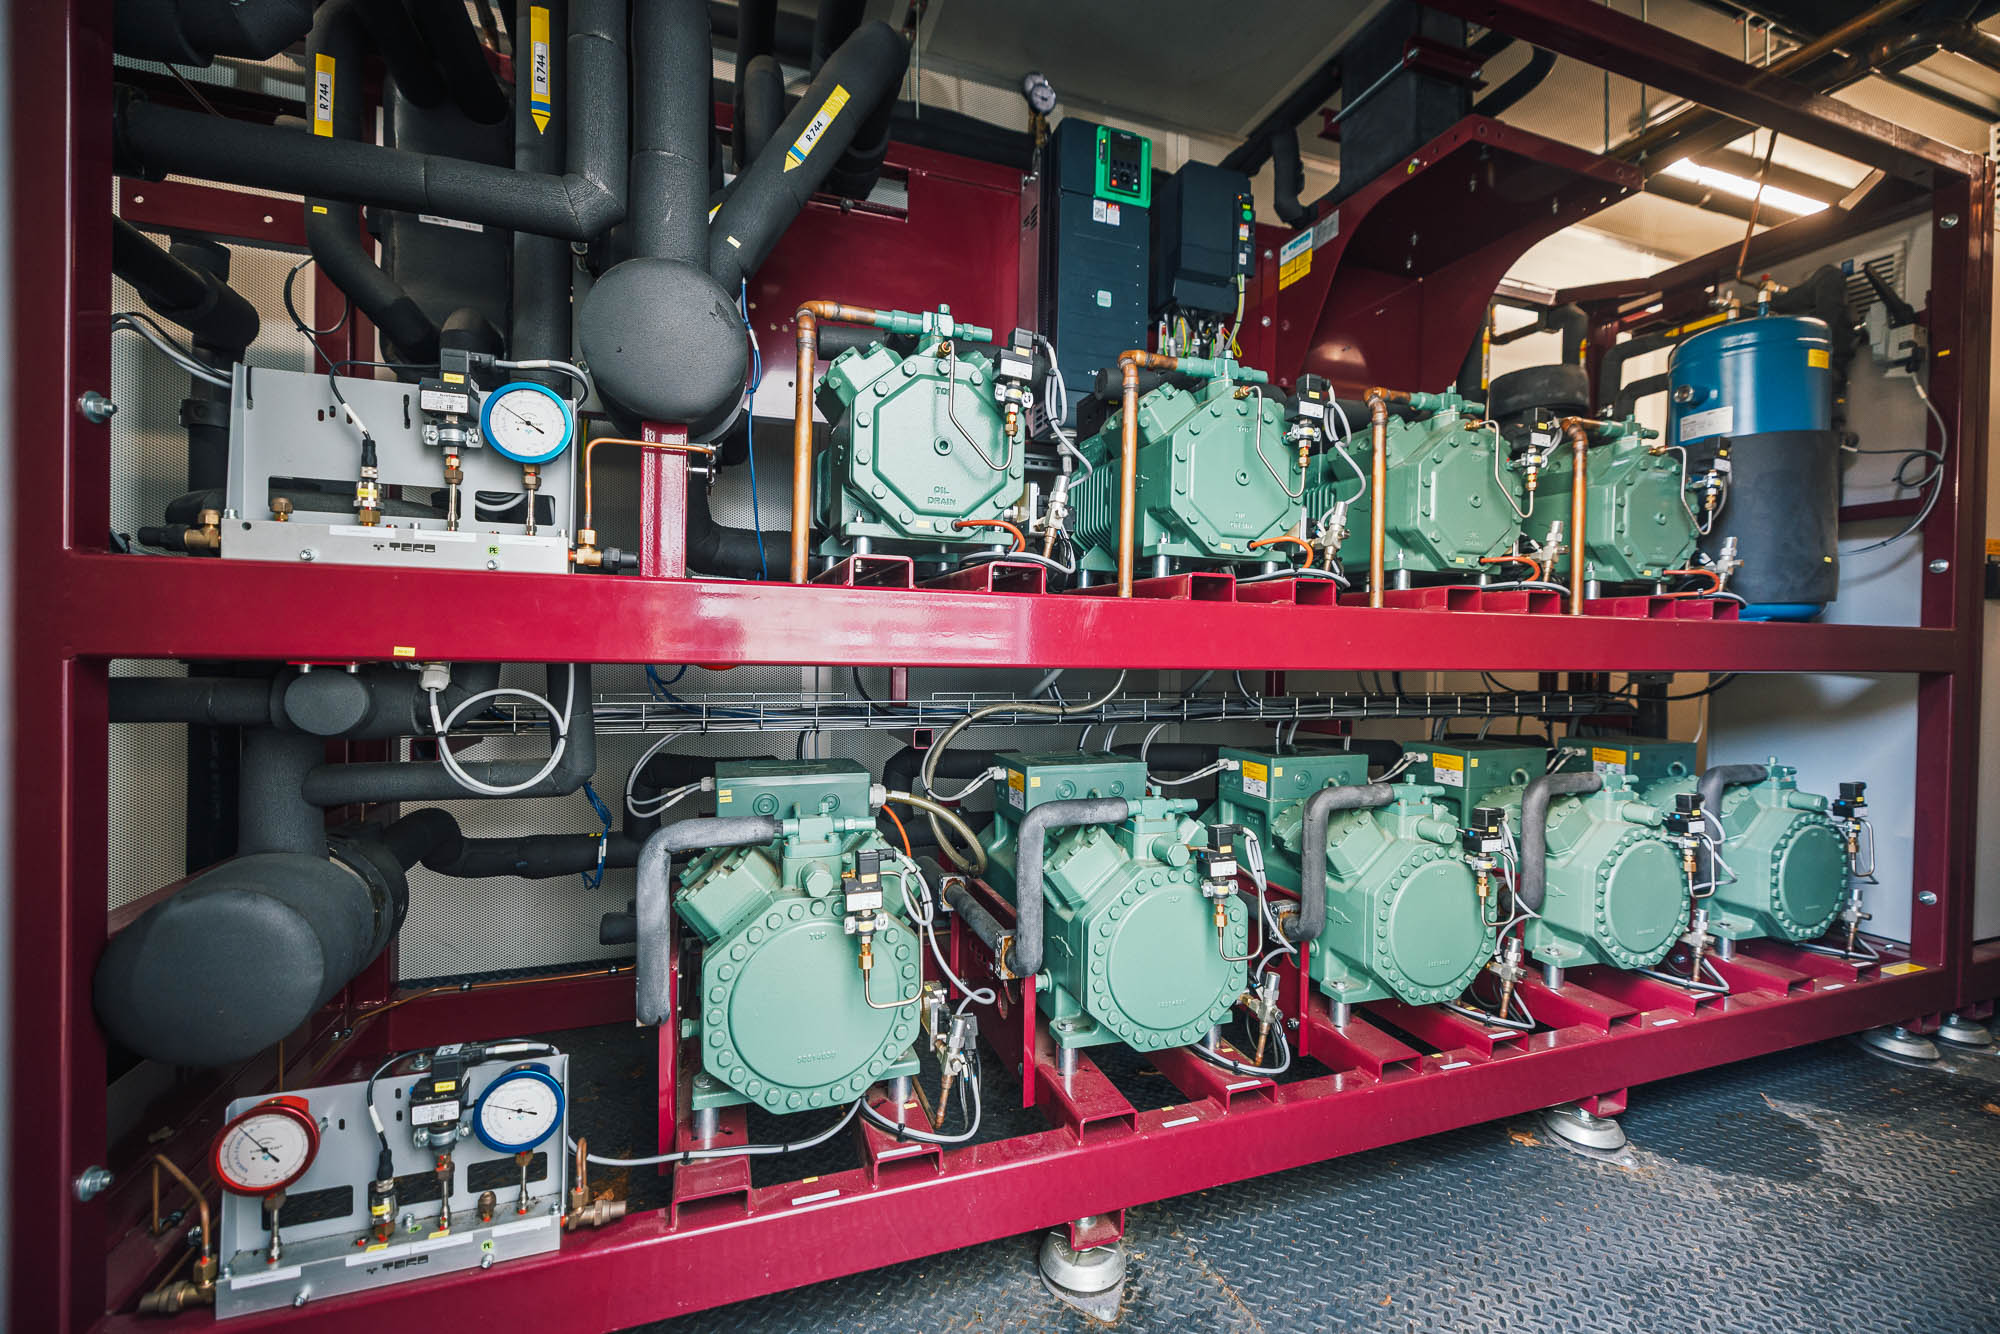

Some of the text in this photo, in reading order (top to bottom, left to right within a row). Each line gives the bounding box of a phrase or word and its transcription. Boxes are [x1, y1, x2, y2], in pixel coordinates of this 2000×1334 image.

[536, 54, 546, 84] R 744
[319, 83, 329, 111] R 744
[805, 120, 823, 142] R 744
[927, 496, 957, 505] DRAIN
[933, 485, 951, 495] OIL
